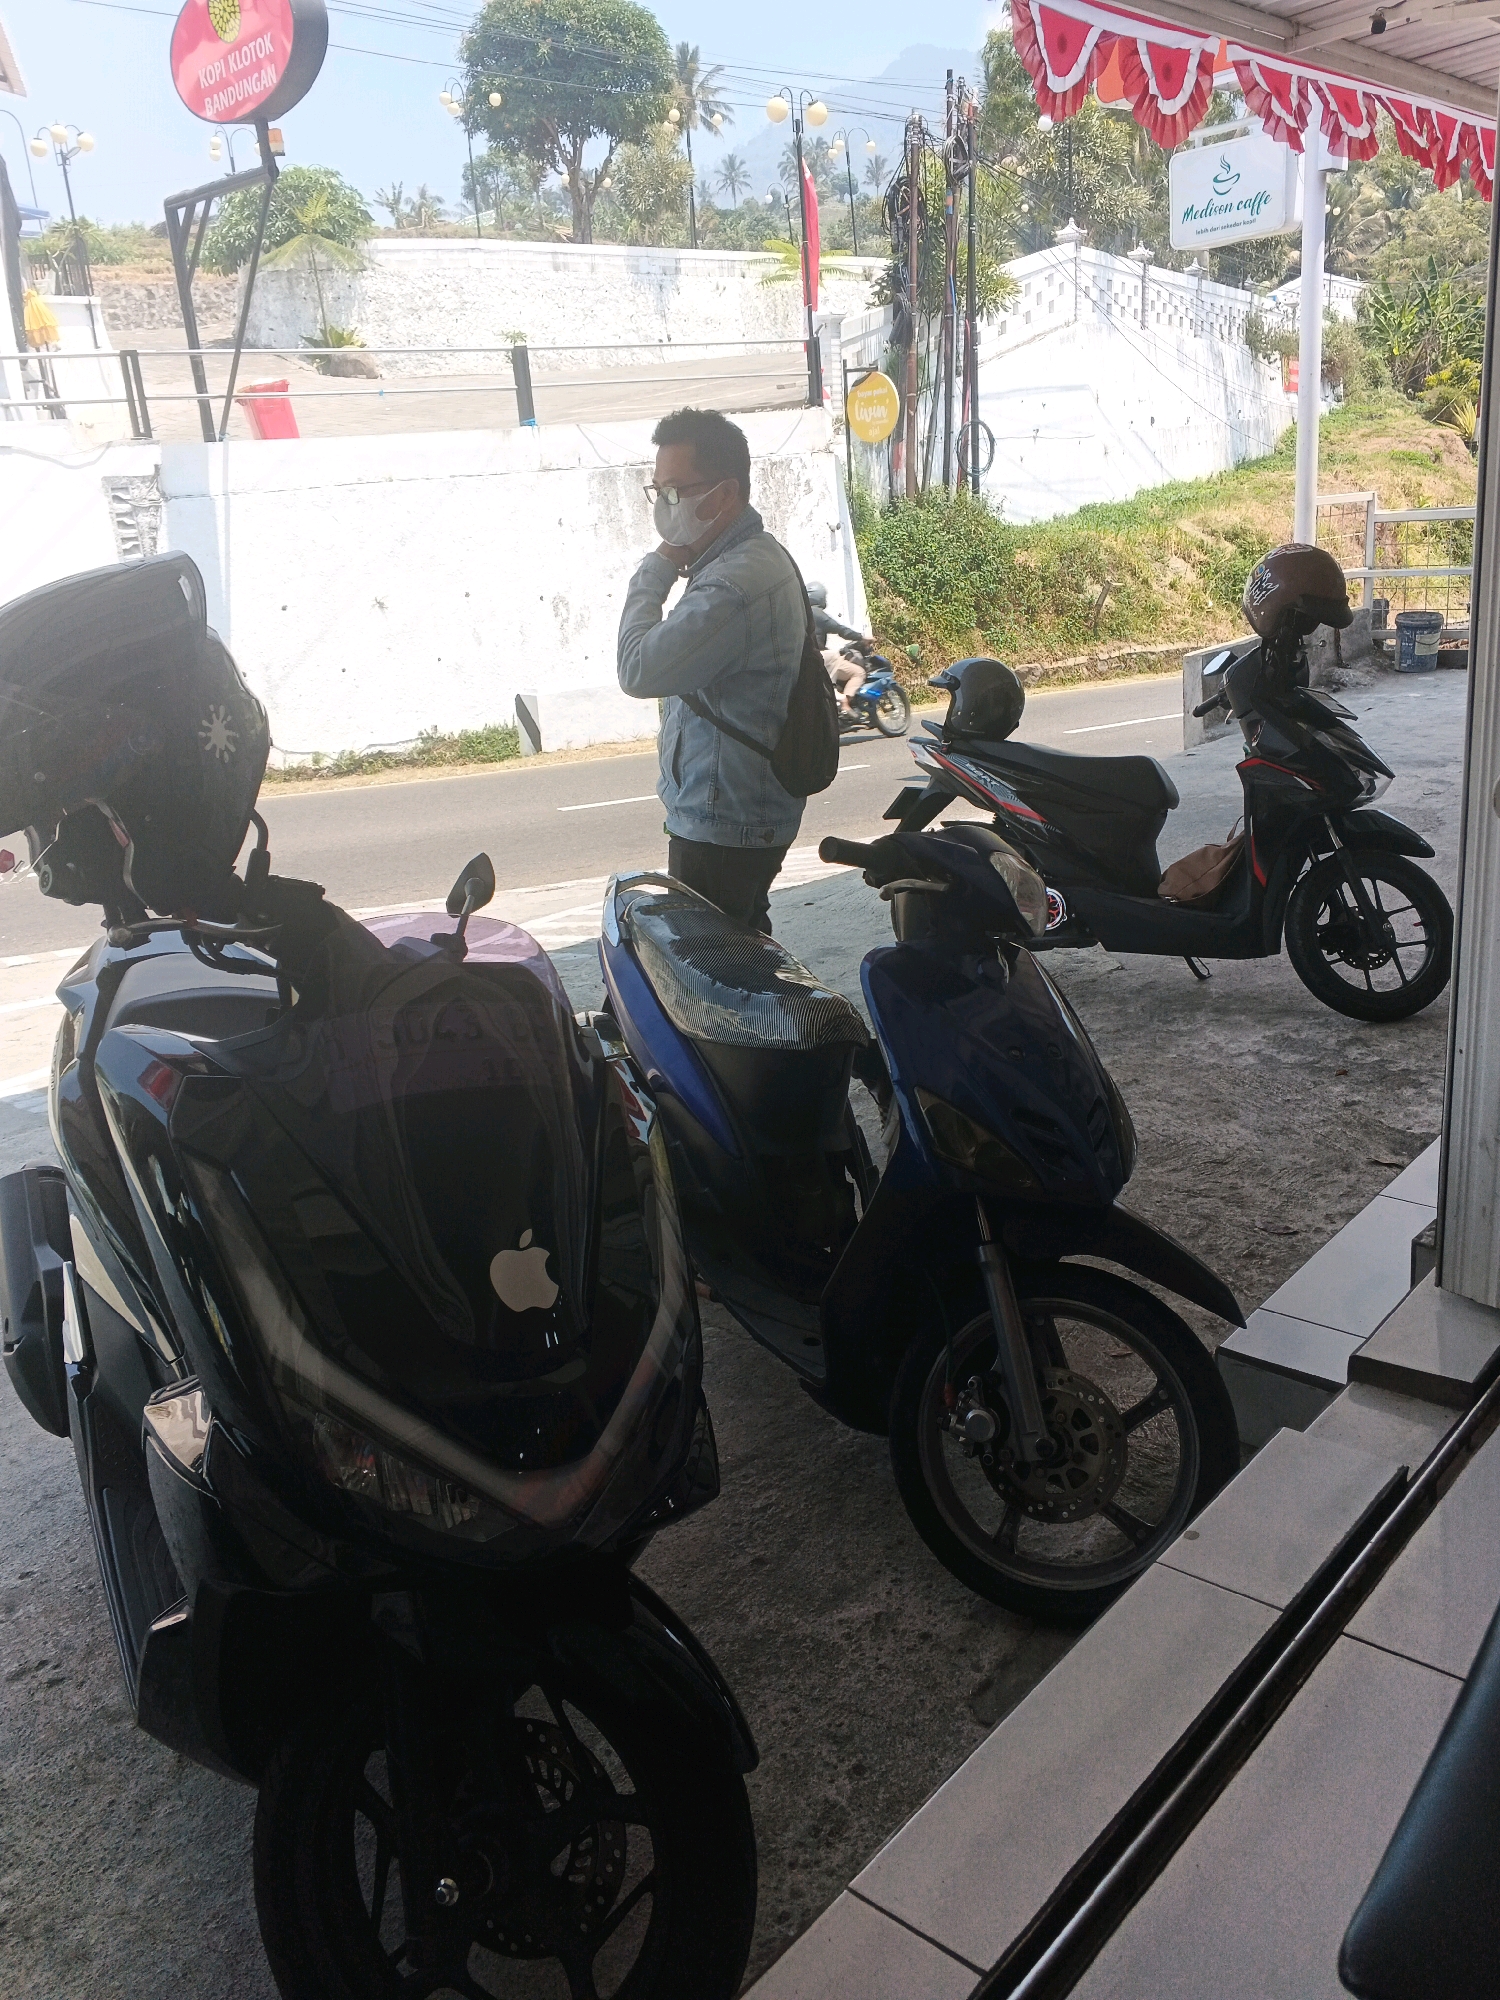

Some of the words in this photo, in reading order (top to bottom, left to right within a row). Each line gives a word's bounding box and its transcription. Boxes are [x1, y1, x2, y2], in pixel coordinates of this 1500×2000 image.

[199, 59, 226, 89] KOPI
[227, 32, 274, 73] KLOTOK
[203, 63, 277, 117] BANDUNGAN
[1181, 198, 1234, 225] Medison
[1236, 190, 1272, 217] caffe
[1220, 222, 1242, 230] sekedar
